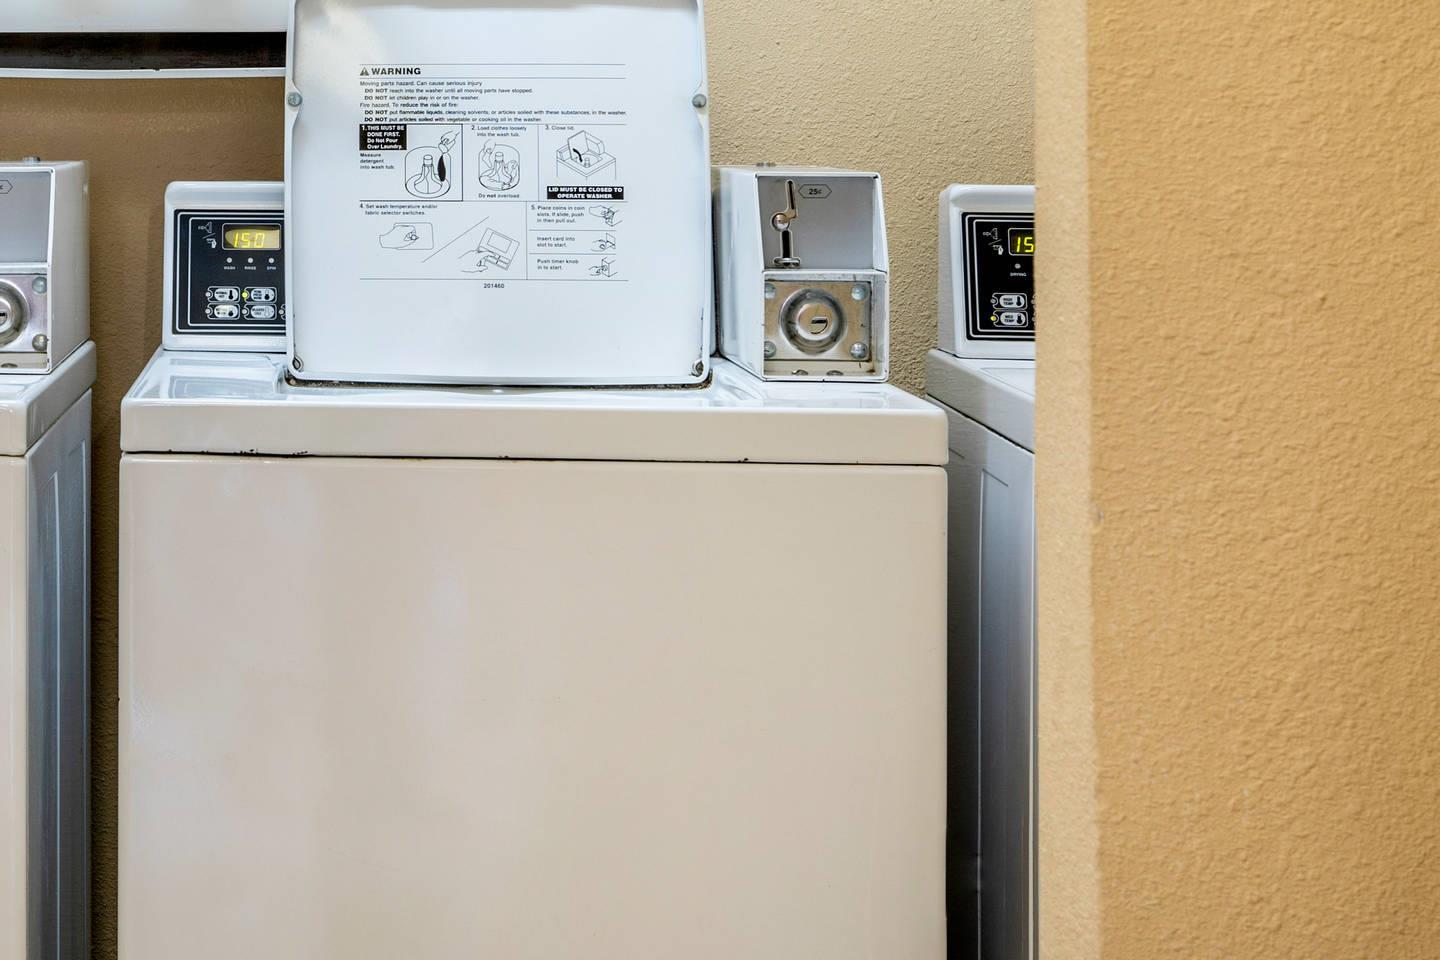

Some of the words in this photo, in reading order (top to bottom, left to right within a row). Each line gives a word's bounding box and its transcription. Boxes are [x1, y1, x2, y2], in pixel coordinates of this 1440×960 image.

[371, 67, 421, 75] WARNING
[234, 232, 265, 249] 150
[1016, 237, 1035, 253] 15
